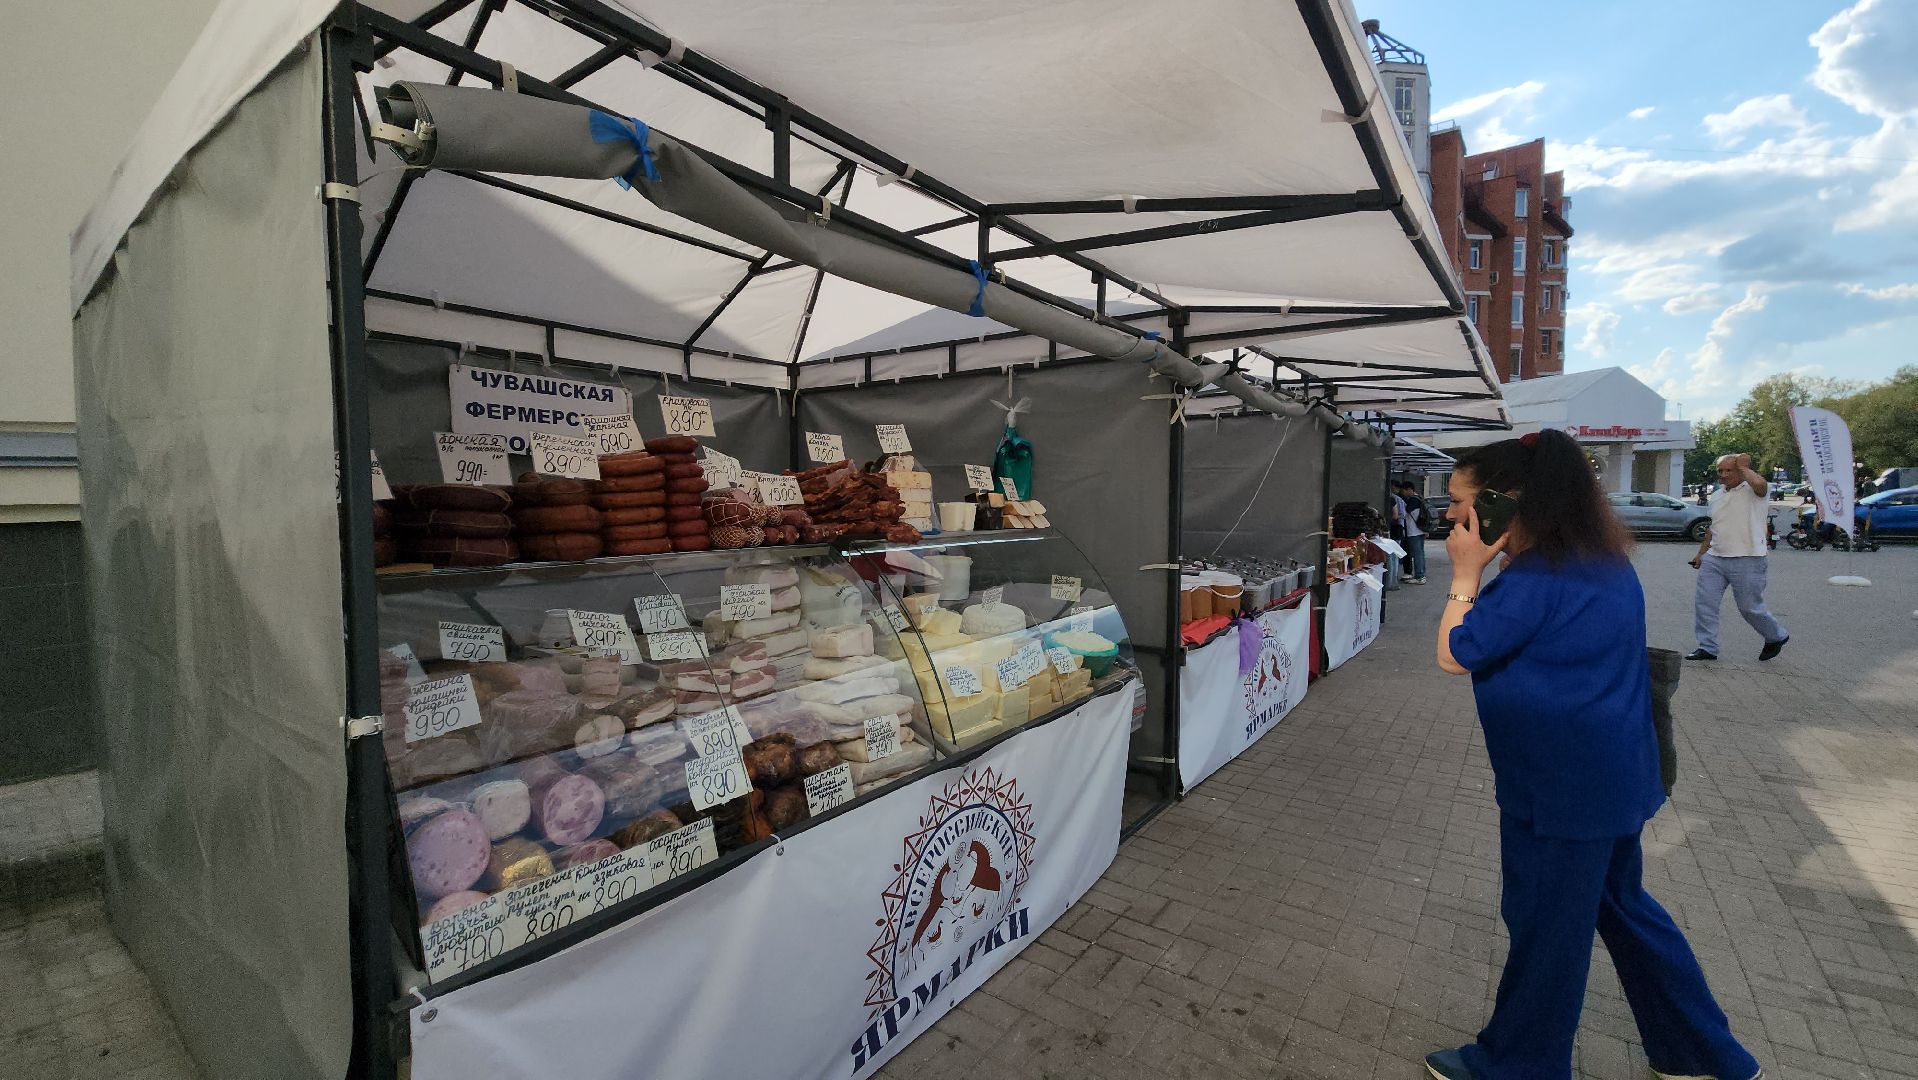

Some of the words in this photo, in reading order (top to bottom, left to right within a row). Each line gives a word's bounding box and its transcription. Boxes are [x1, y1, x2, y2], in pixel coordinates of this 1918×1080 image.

[471, 370, 614, 402] ЧУВАШСКАЯ
[465, 401, 588, 427] ФЕРМЕРС
[450, 641, 491, 661] 790
[415, 706, 461, 737] 990
[702, 727, 732, 755] 890
[701, 768, 737, 805] 890
[574, 853, 626, 884] Колбаса
[592, 857, 646, 887] языковая
[668, 845, 703, 881] 890
[903, 809, 1016, 930] ВСЕРОССИЙСКИЕ
[504, 867, 576, 906] Запеченны
[592, 875, 637, 915] 890
[523, 904, 574, 945] 890
[453, 926, 505, 971] 790
[850, 907, 1031, 1078] ЯРМАРКИ
